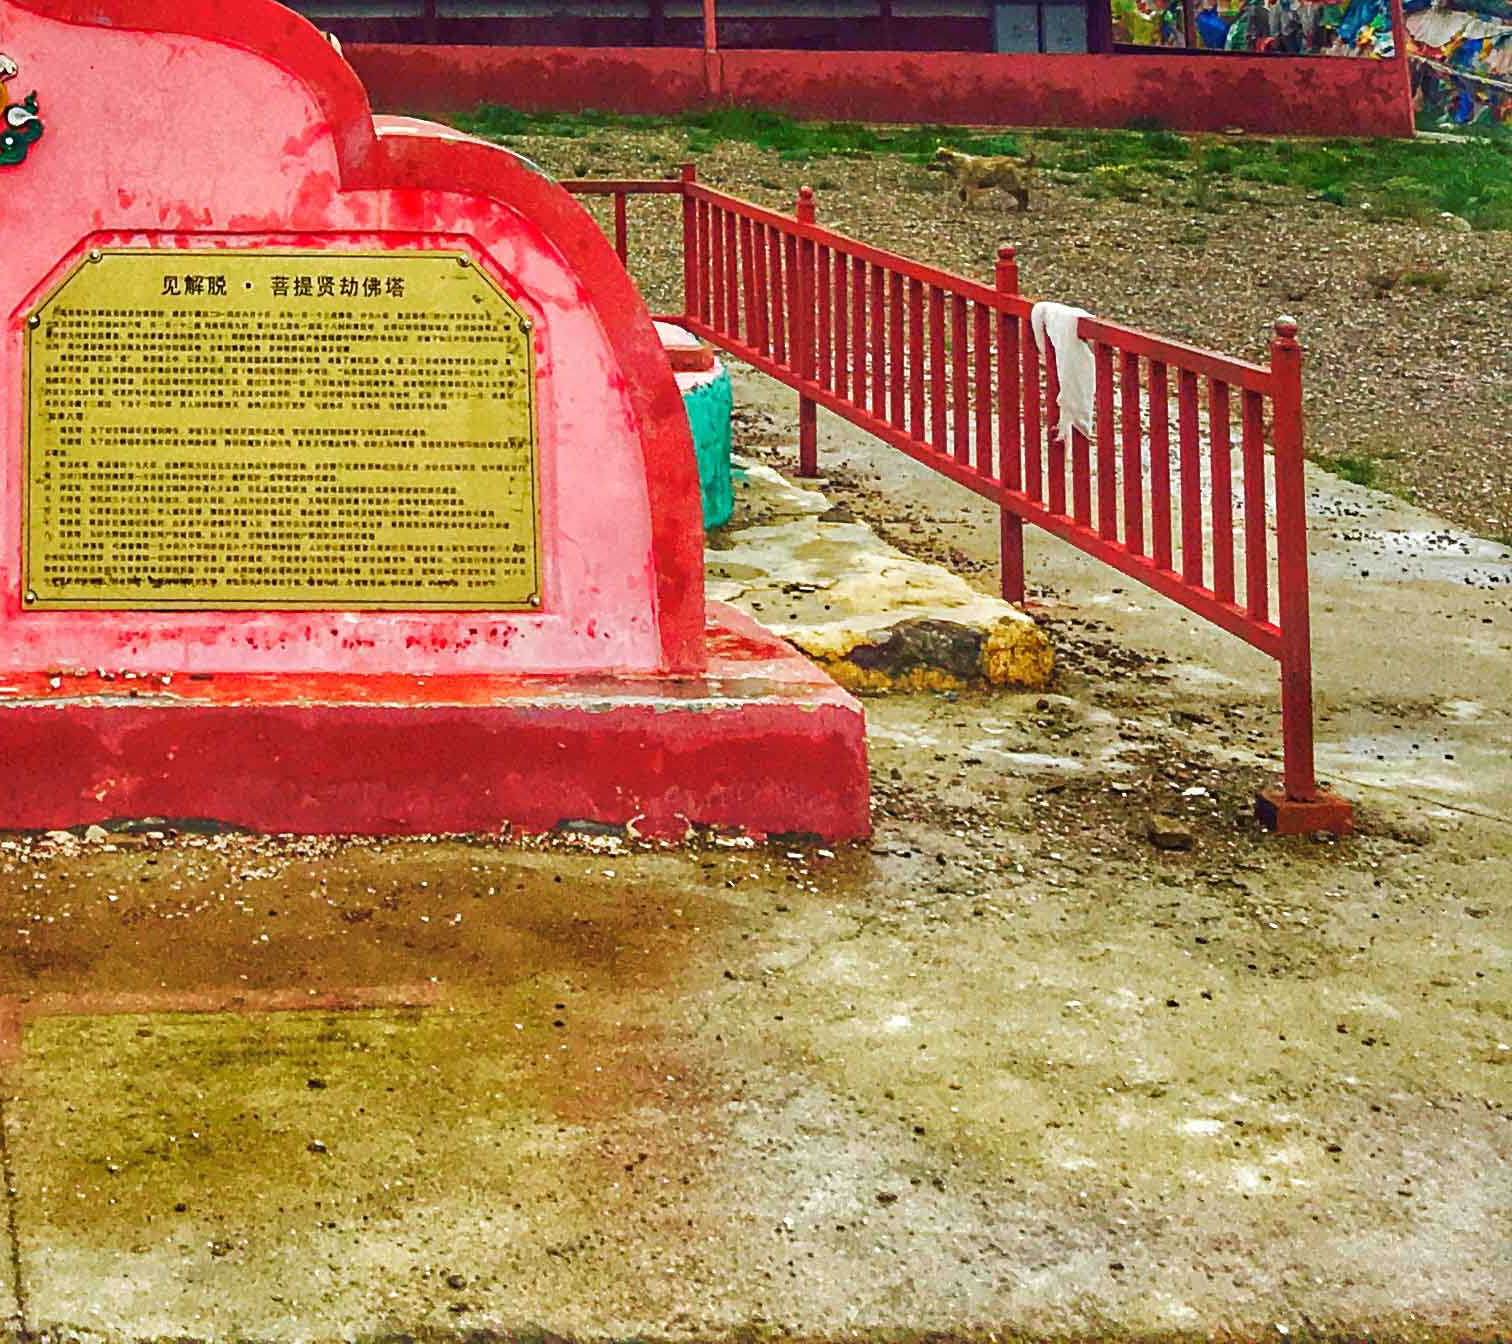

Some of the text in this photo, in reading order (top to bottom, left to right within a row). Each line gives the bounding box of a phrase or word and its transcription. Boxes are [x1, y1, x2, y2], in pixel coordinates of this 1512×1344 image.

[161, 275, 226, 297] 见解脱
[271, 275, 405, 297] 菩提贤劫佛塔
